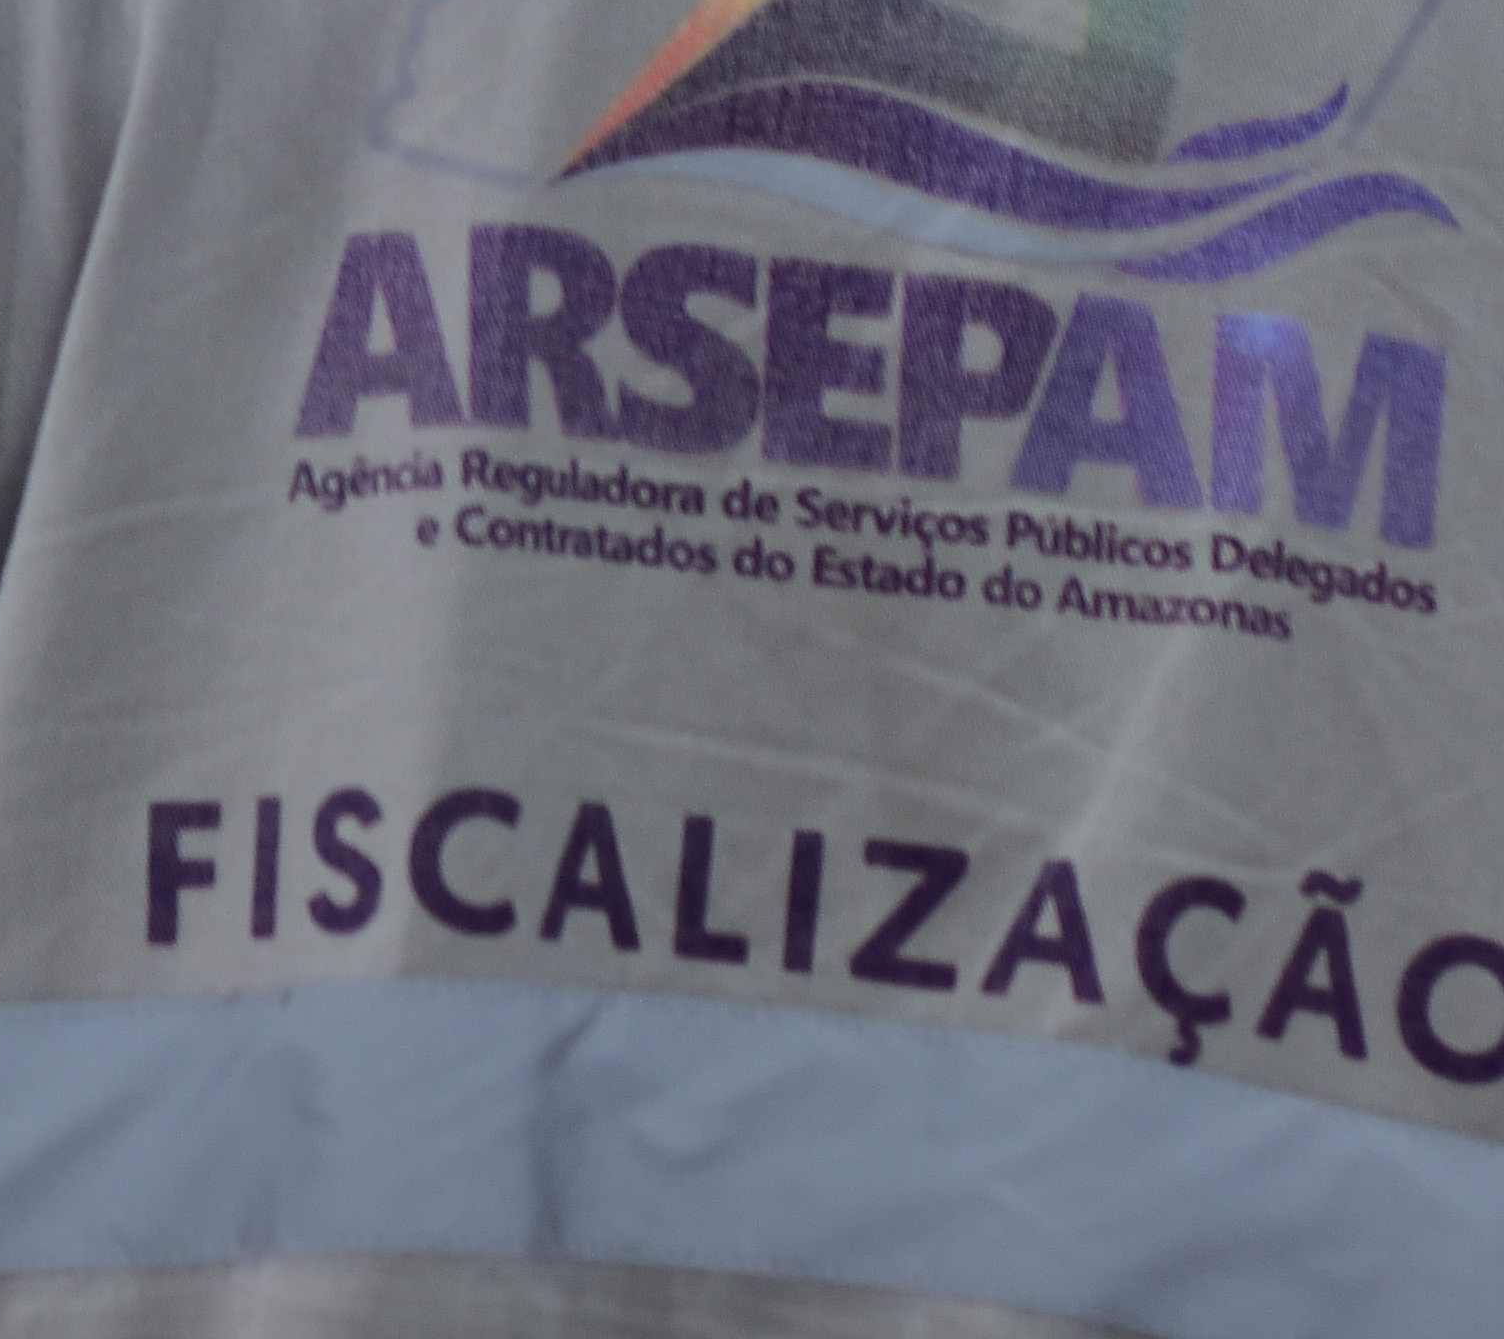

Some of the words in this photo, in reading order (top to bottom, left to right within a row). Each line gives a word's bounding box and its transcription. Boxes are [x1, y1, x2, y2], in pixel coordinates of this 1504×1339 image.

[292, 223, 1446, 549] ARSEPAM
[287, 448, 444, 514] Agência
[461, 447, 705, 517] Reguladora
[722, 476, 780, 523] de
[794, 485, 989, 549] Serviços
[1005, 510, 1193, 571] Públicos
[1211, 531, 1438, 615] Delegados
[415, 516, 440, 549] e
[454, 504, 718, 574] Contratados
[732, 533, 795, 583] do
[812, 542, 966, 602] Estado
[981, 563, 1043, 612] do
[1055, 574, 1292, 641] Amazonas
